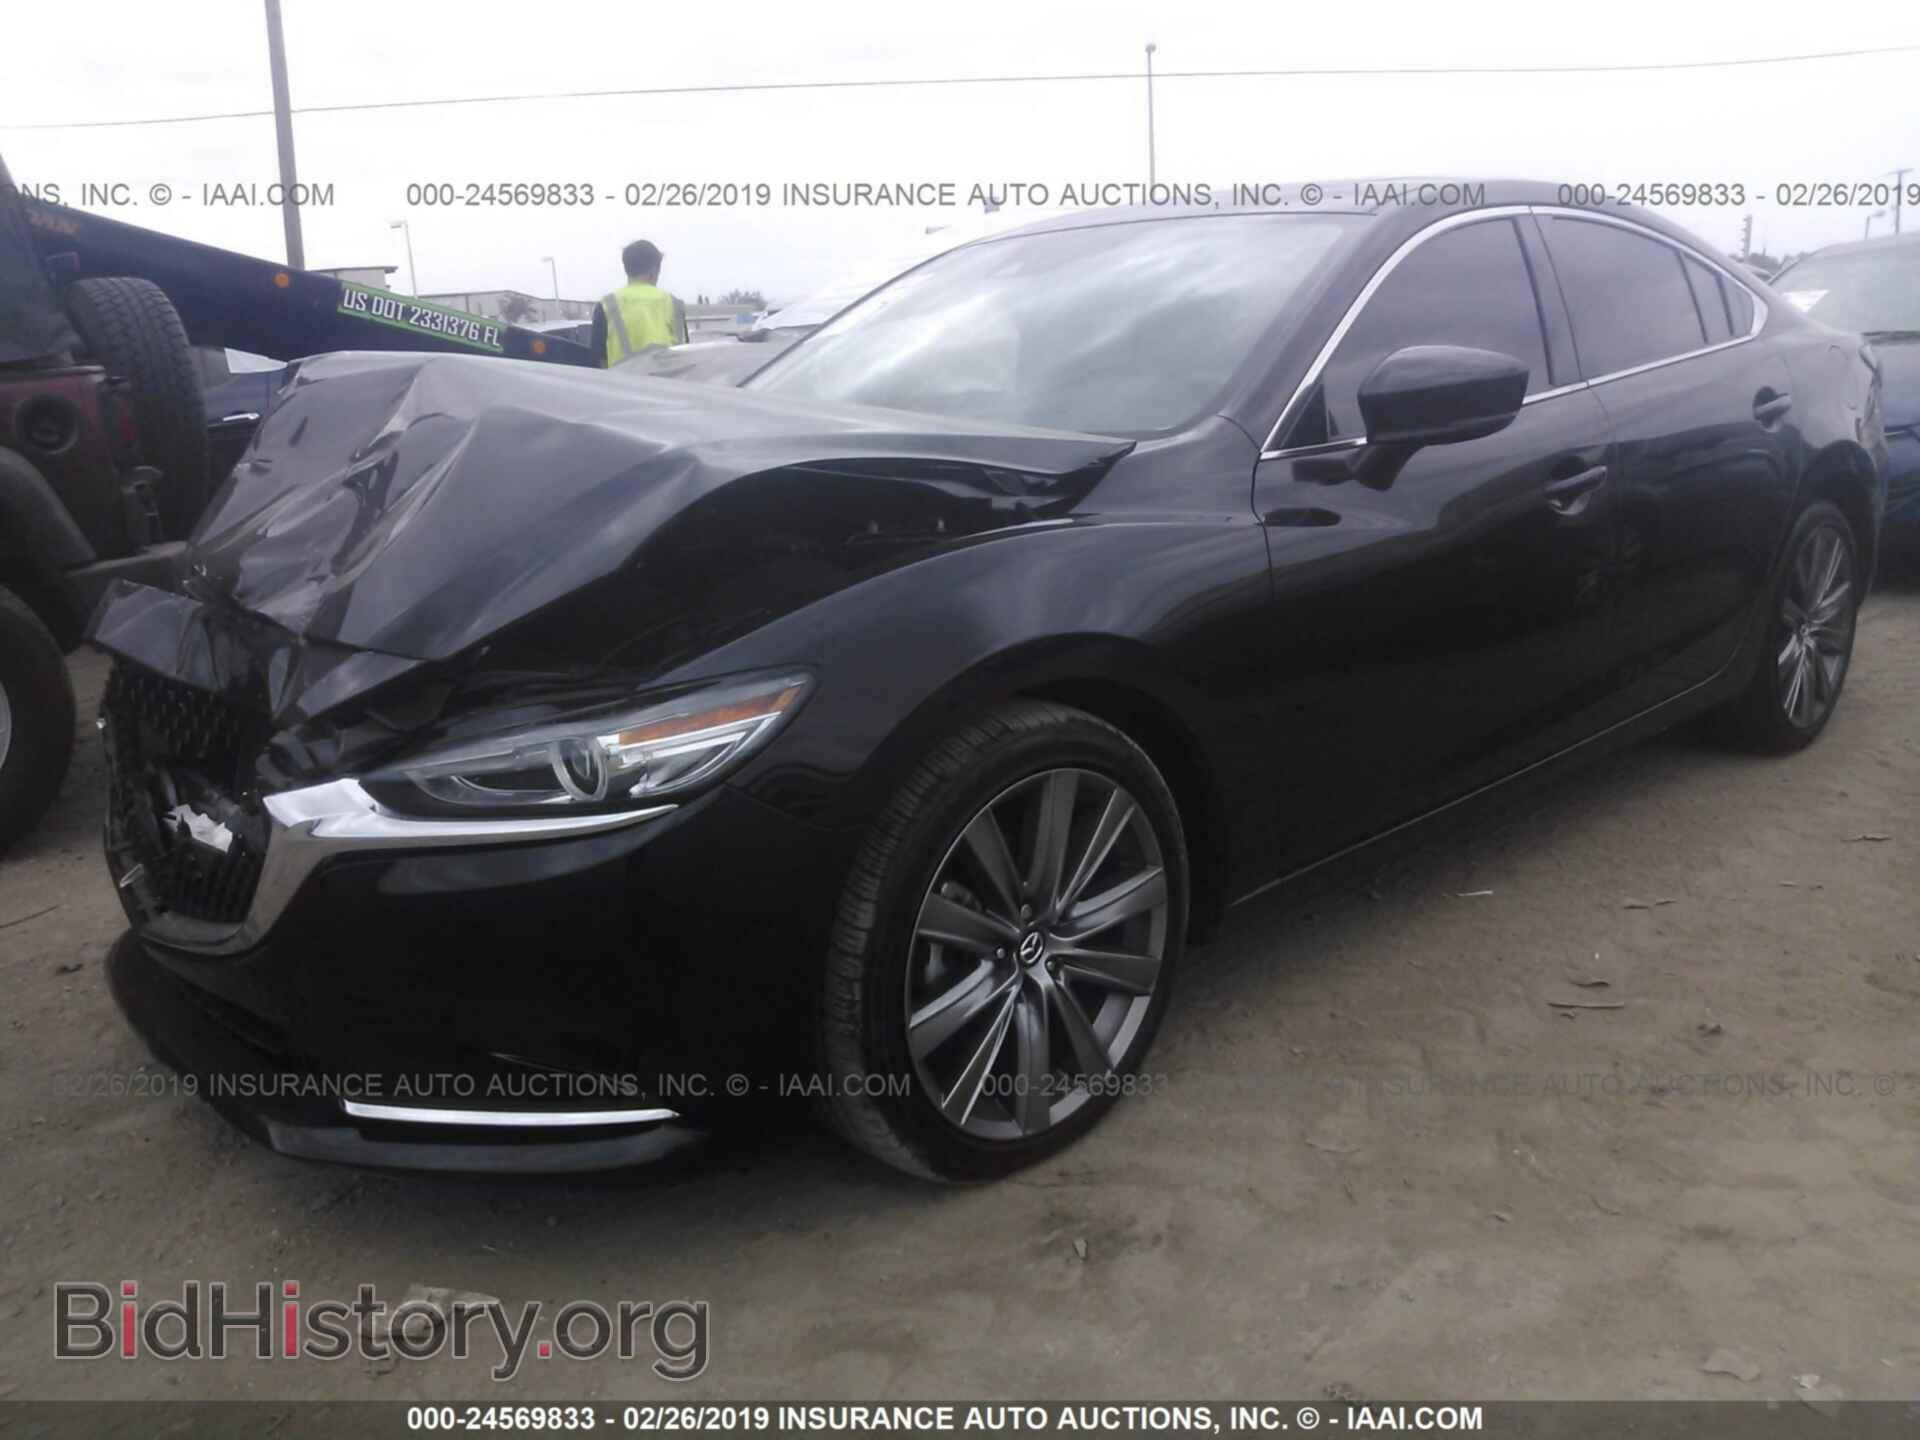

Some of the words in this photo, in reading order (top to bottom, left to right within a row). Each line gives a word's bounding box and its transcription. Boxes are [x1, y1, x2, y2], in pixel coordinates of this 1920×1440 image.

[343, 288, 368, 312] US
[371, 296, 407, 321] DOT
[409, 306, 481, 341] 2331376
[483, 326, 501, 347] FL
